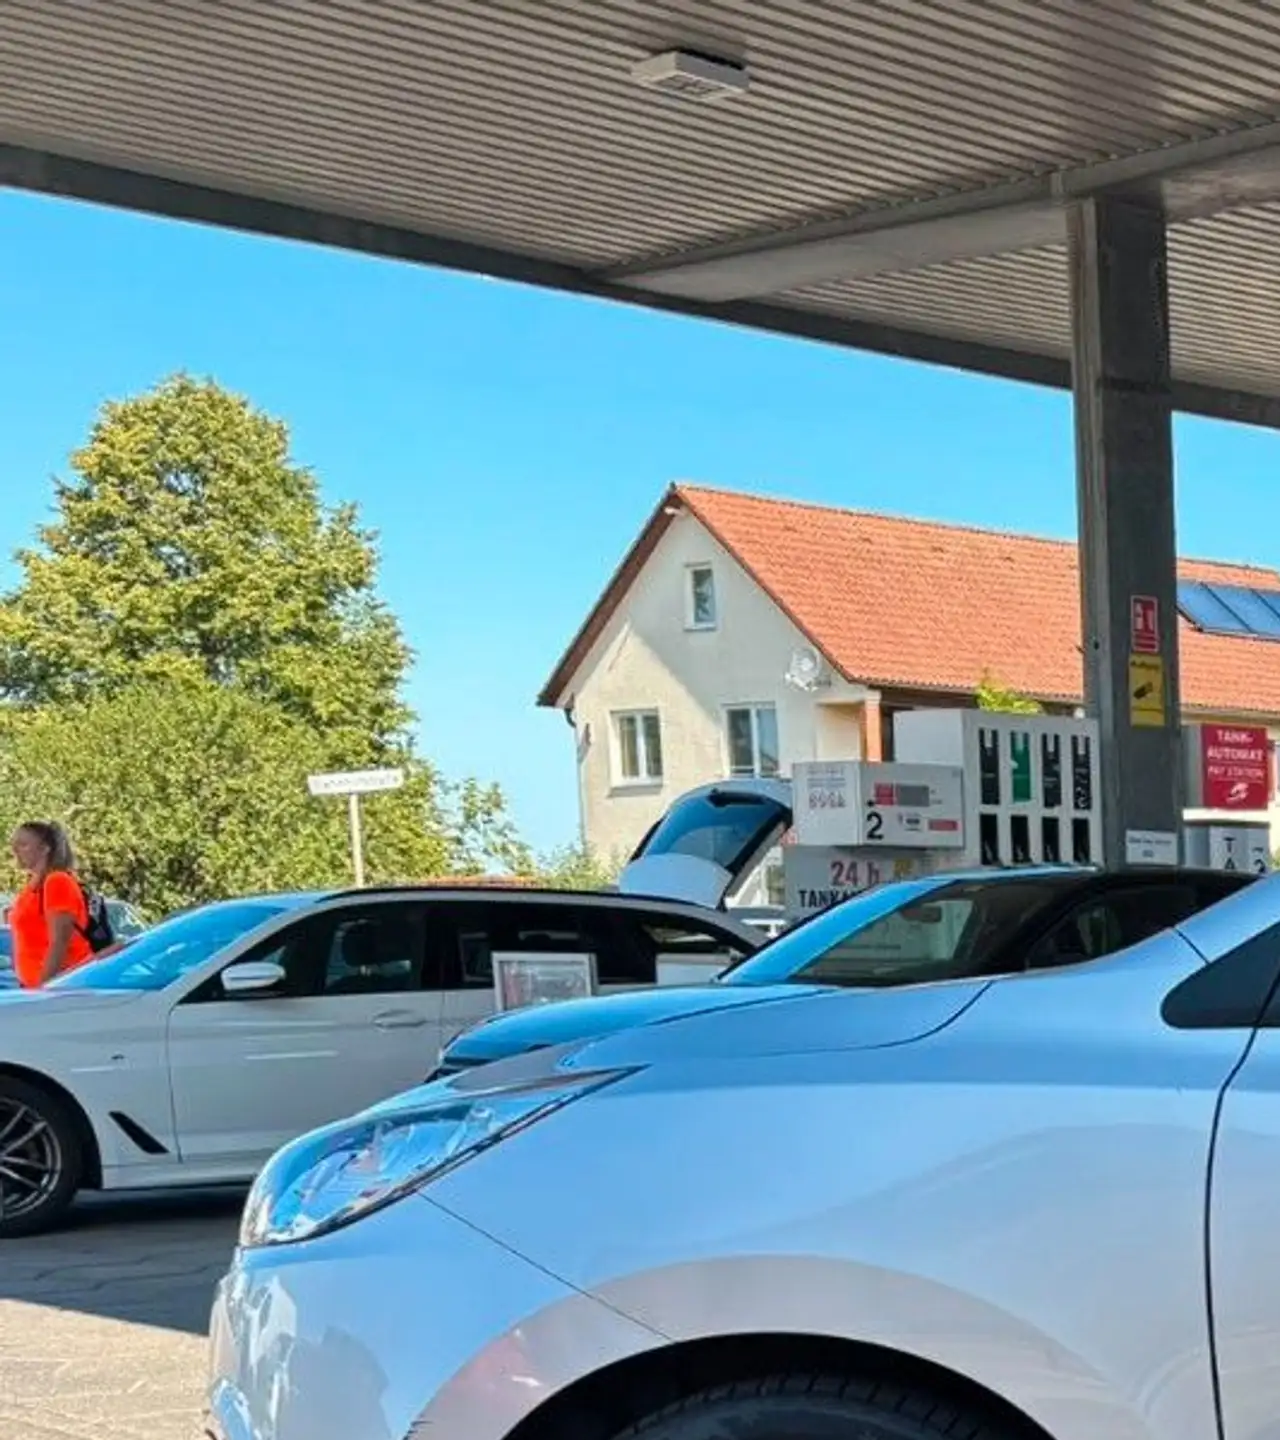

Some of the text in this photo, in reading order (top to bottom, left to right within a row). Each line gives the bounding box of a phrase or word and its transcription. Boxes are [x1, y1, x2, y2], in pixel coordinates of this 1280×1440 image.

[1207, 746, 1264, 761] AUTOMAT
[866, 811, 884, 841] 2
[830, 860, 880, 887] 24 h
